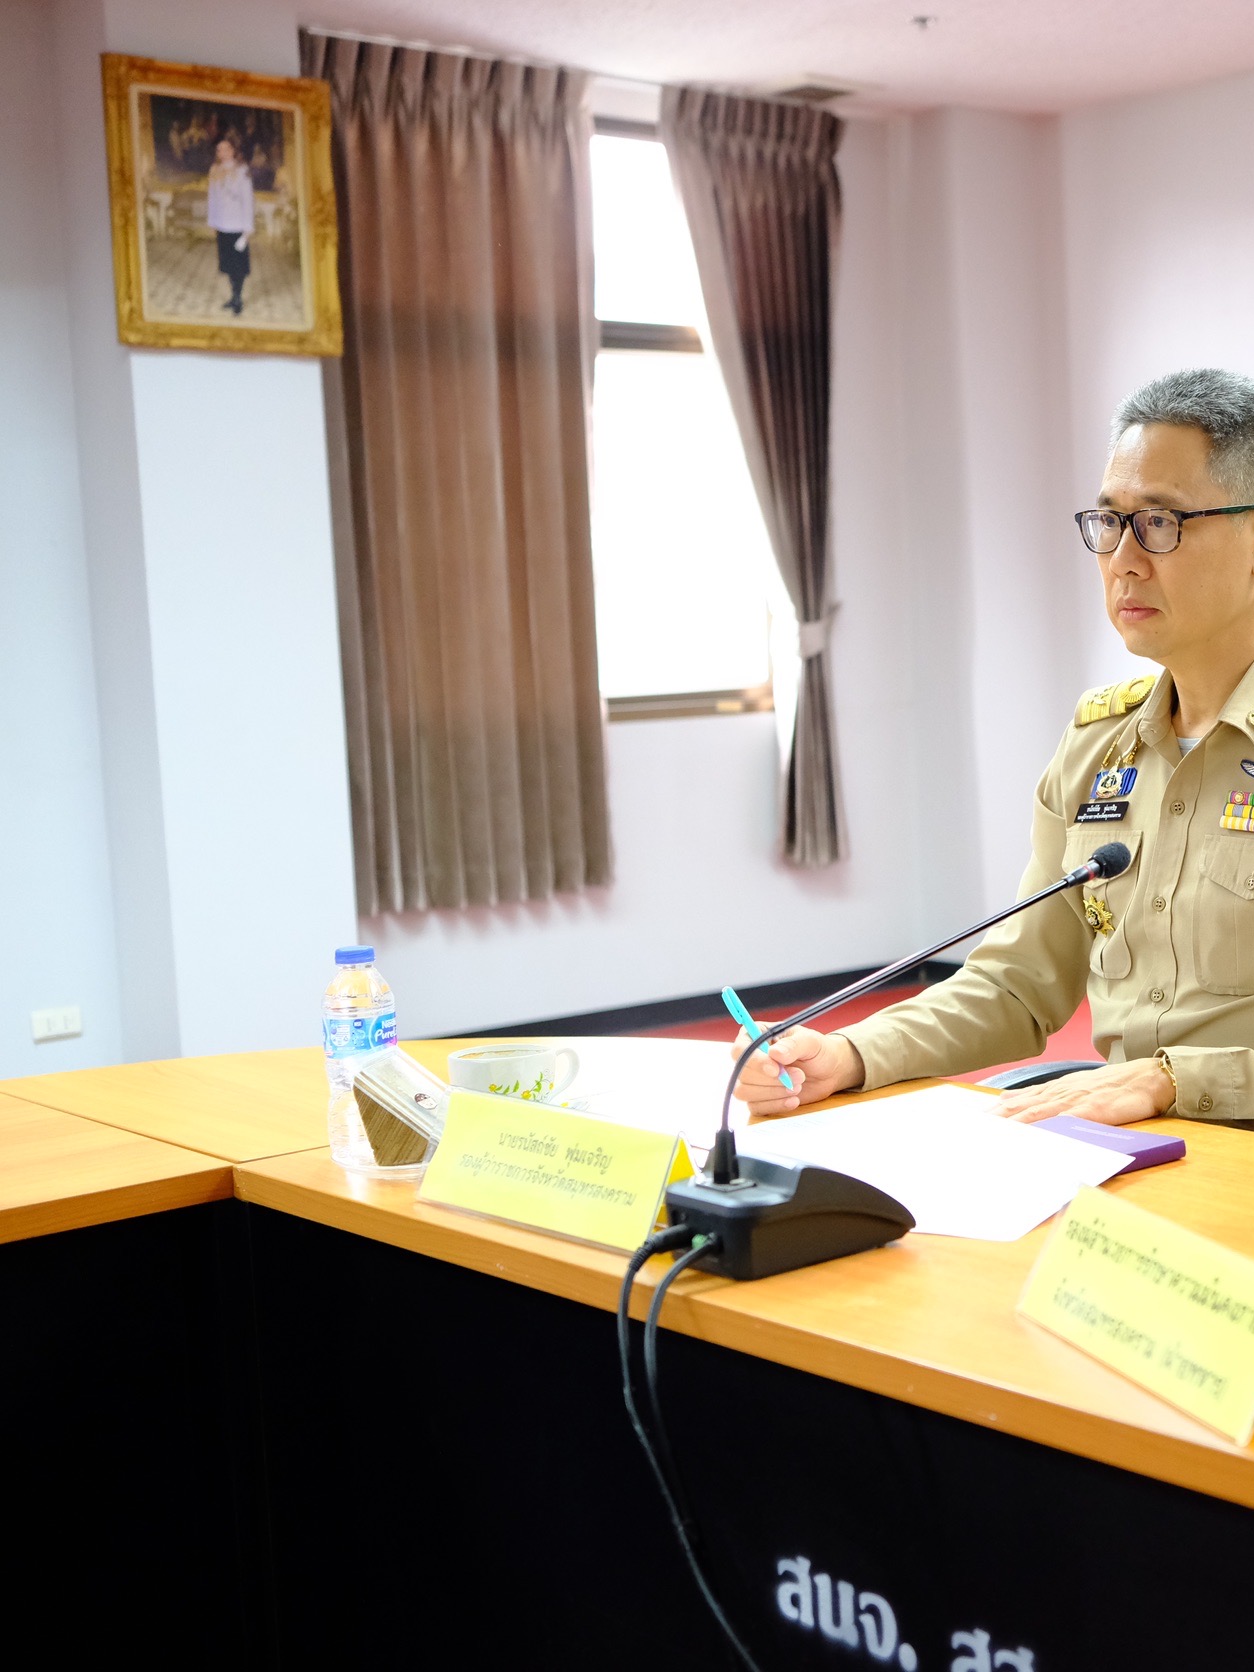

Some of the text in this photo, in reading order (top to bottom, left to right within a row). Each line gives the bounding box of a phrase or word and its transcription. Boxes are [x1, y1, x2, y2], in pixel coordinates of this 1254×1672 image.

[459, 1151, 636, 1206] รองผู้ว่าราชการจังหวัดสมุทรสงคราม
[566, 1143, 613, 1175] พุ่มเจริญ
[776, 1556, 918, 1671] สนจ.
